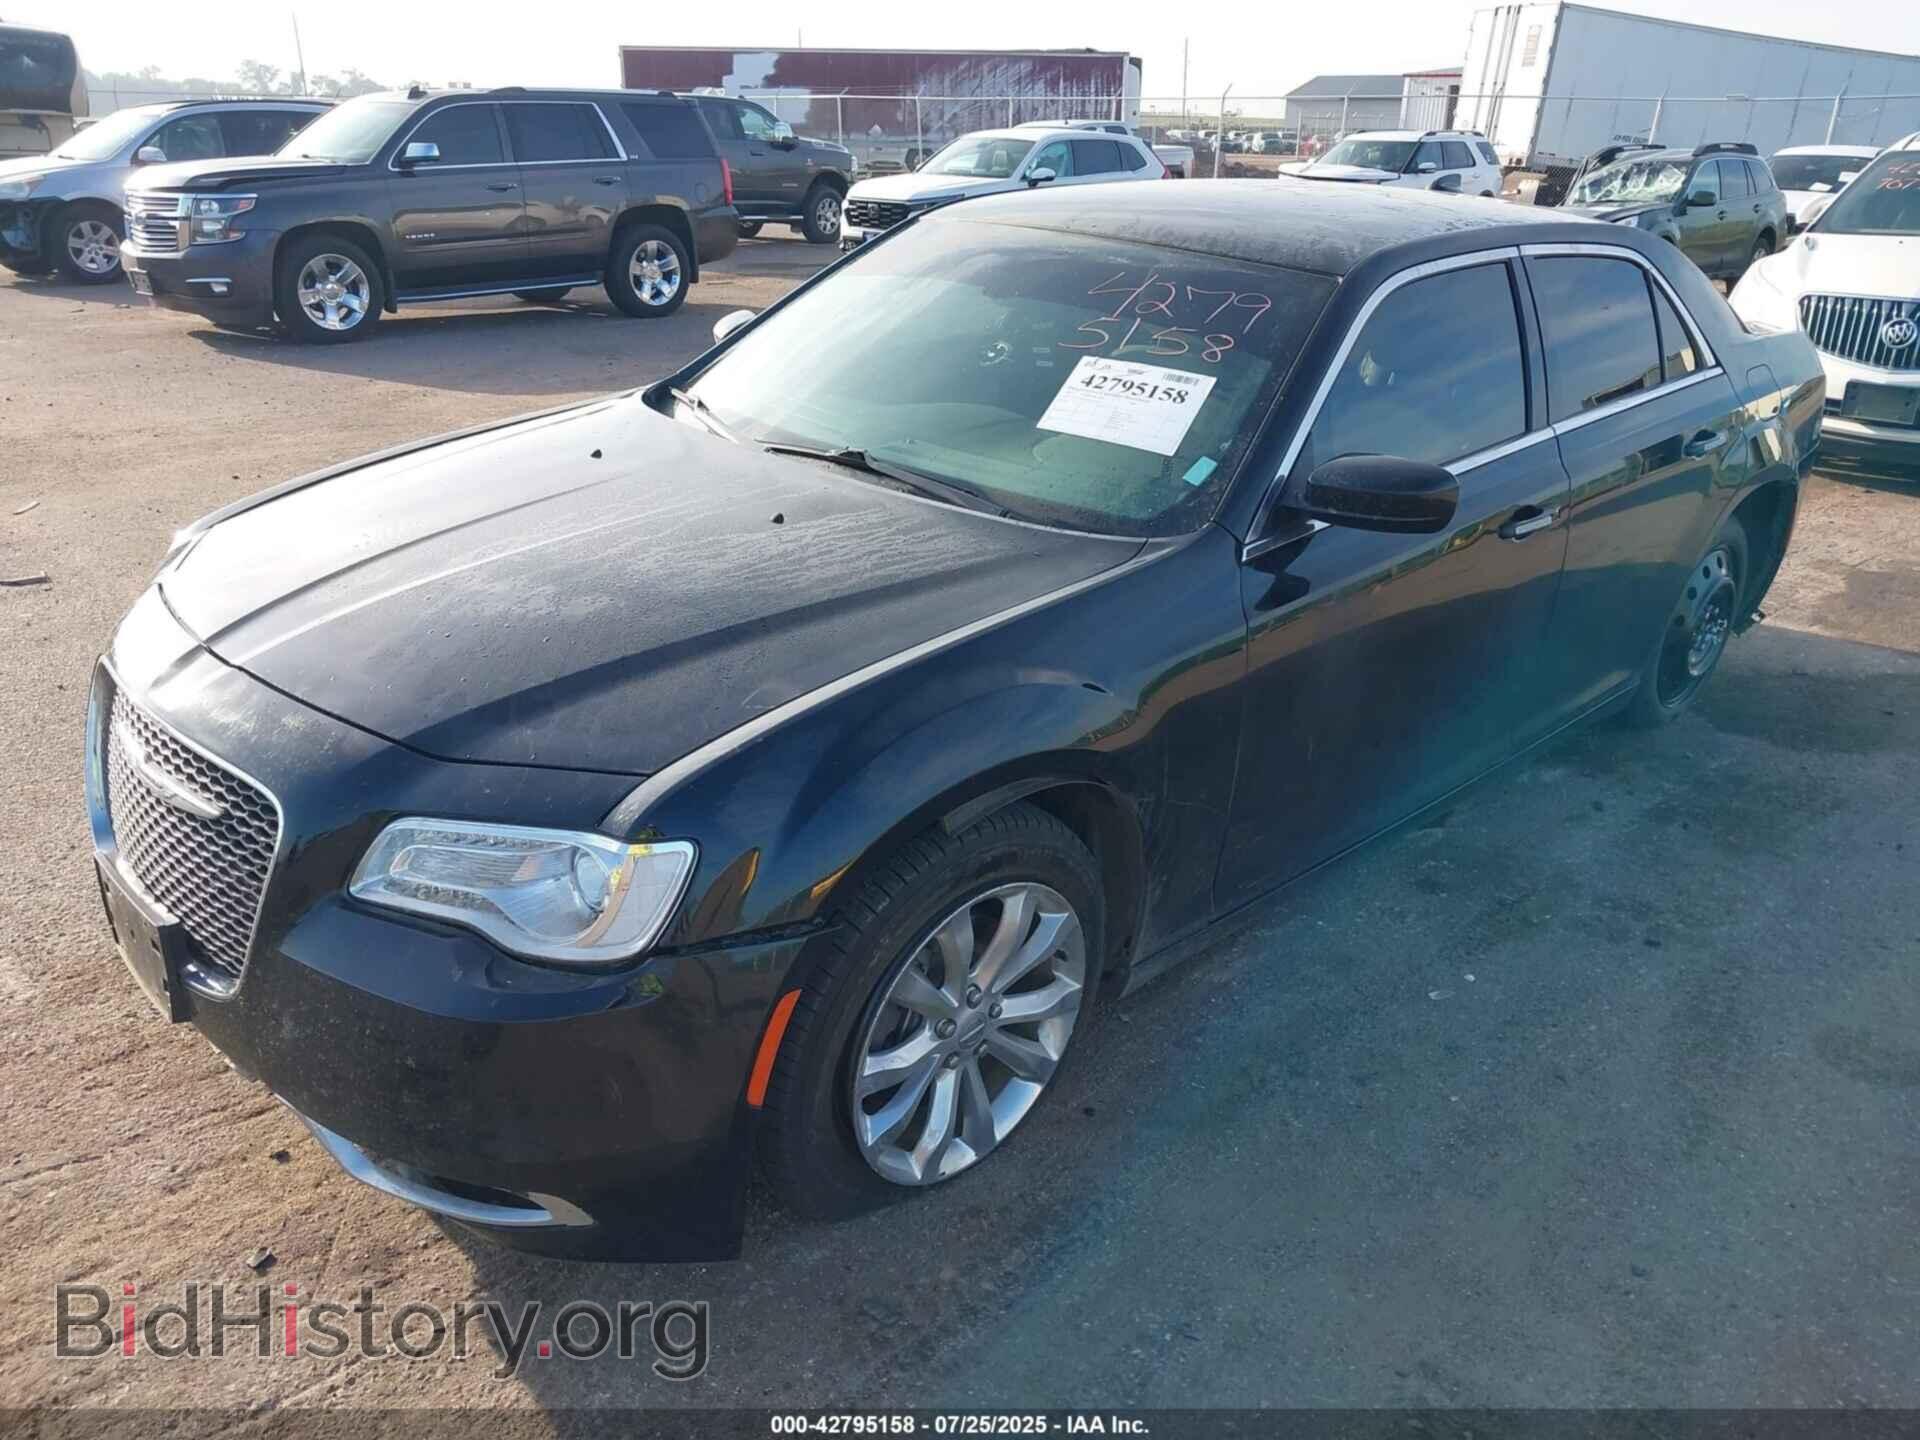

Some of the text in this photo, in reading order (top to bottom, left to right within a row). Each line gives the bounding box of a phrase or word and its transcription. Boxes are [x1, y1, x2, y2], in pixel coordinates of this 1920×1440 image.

[1088, 271, 1272, 334] 4279
[1057, 317, 1234, 363] 5158
[1080, 373, 1189, 404] 42795158
